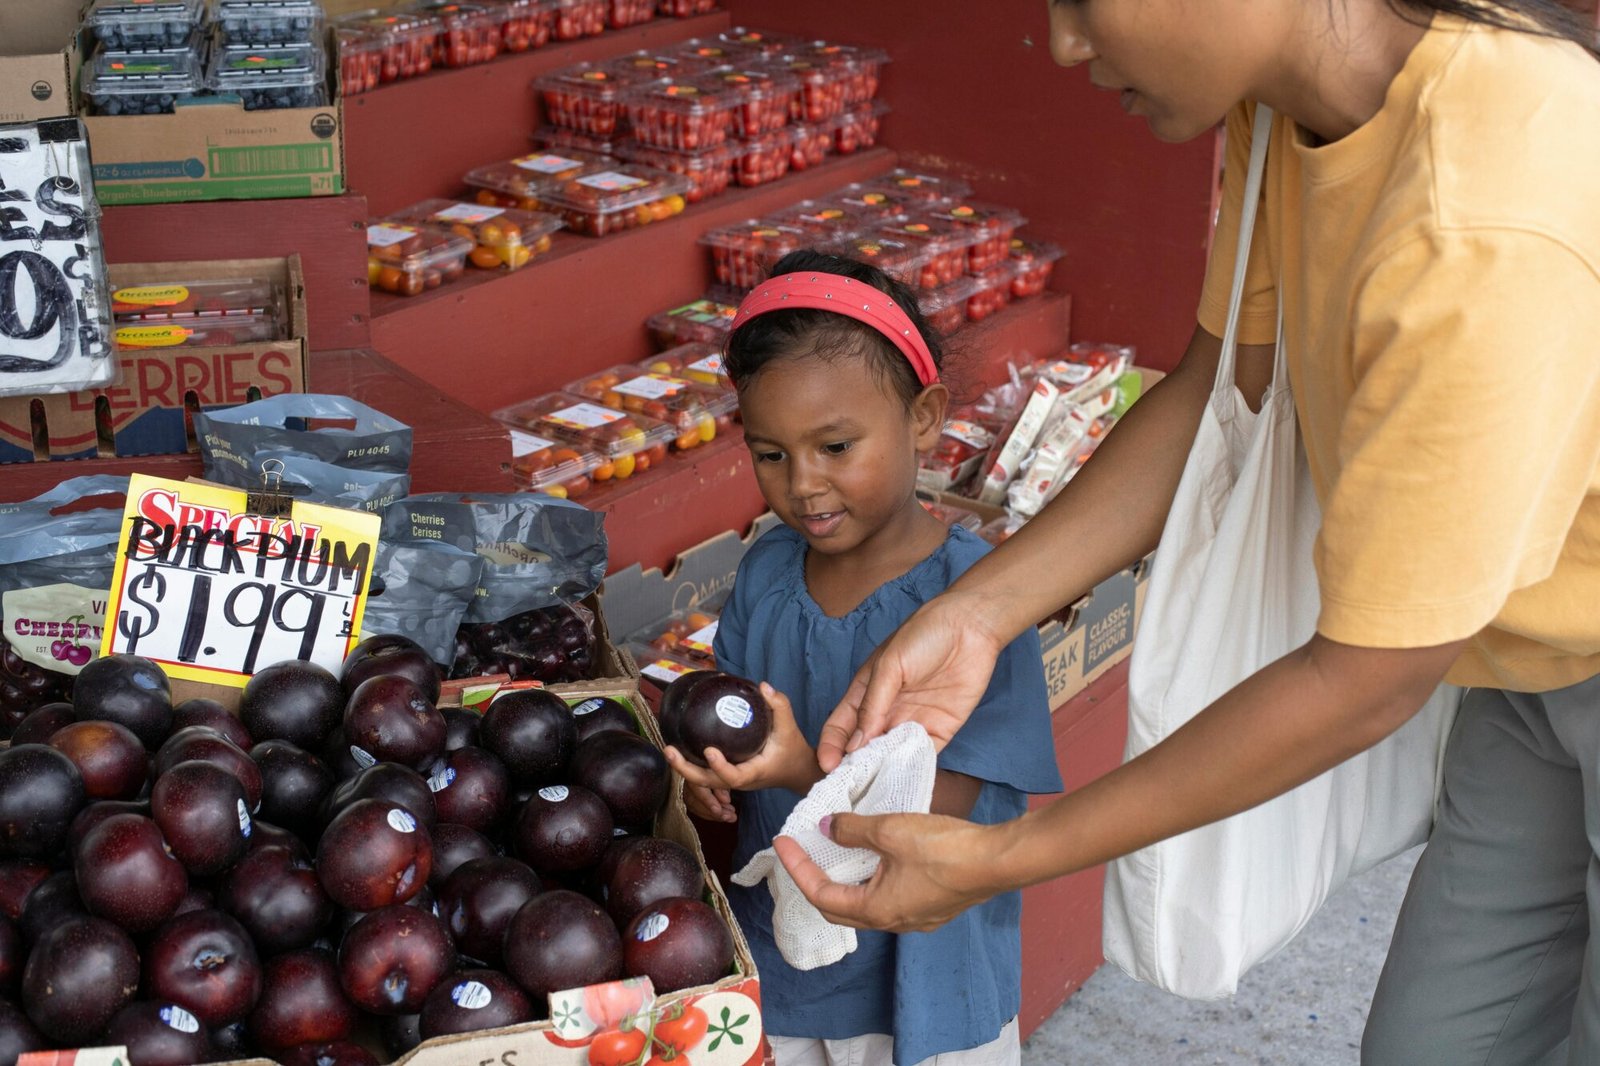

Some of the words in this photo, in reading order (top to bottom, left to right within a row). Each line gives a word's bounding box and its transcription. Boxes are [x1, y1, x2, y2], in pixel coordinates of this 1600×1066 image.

[97, 189, 140, 202] Organic
[142, 188, 203, 199] Blueberries
[69, 350, 293, 412] ERRIES
[347, 449, 366, 459] PLU
[366, 445, 390, 455] 4045
[366, 499, 379, 512] PLU
[411, 512, 446, 526] Cherries
[412, 526, 442, 539] Cerises
[119, 564, 327, 675] $1.99
[1087, 626, 1128, 665] FLAVOUR
